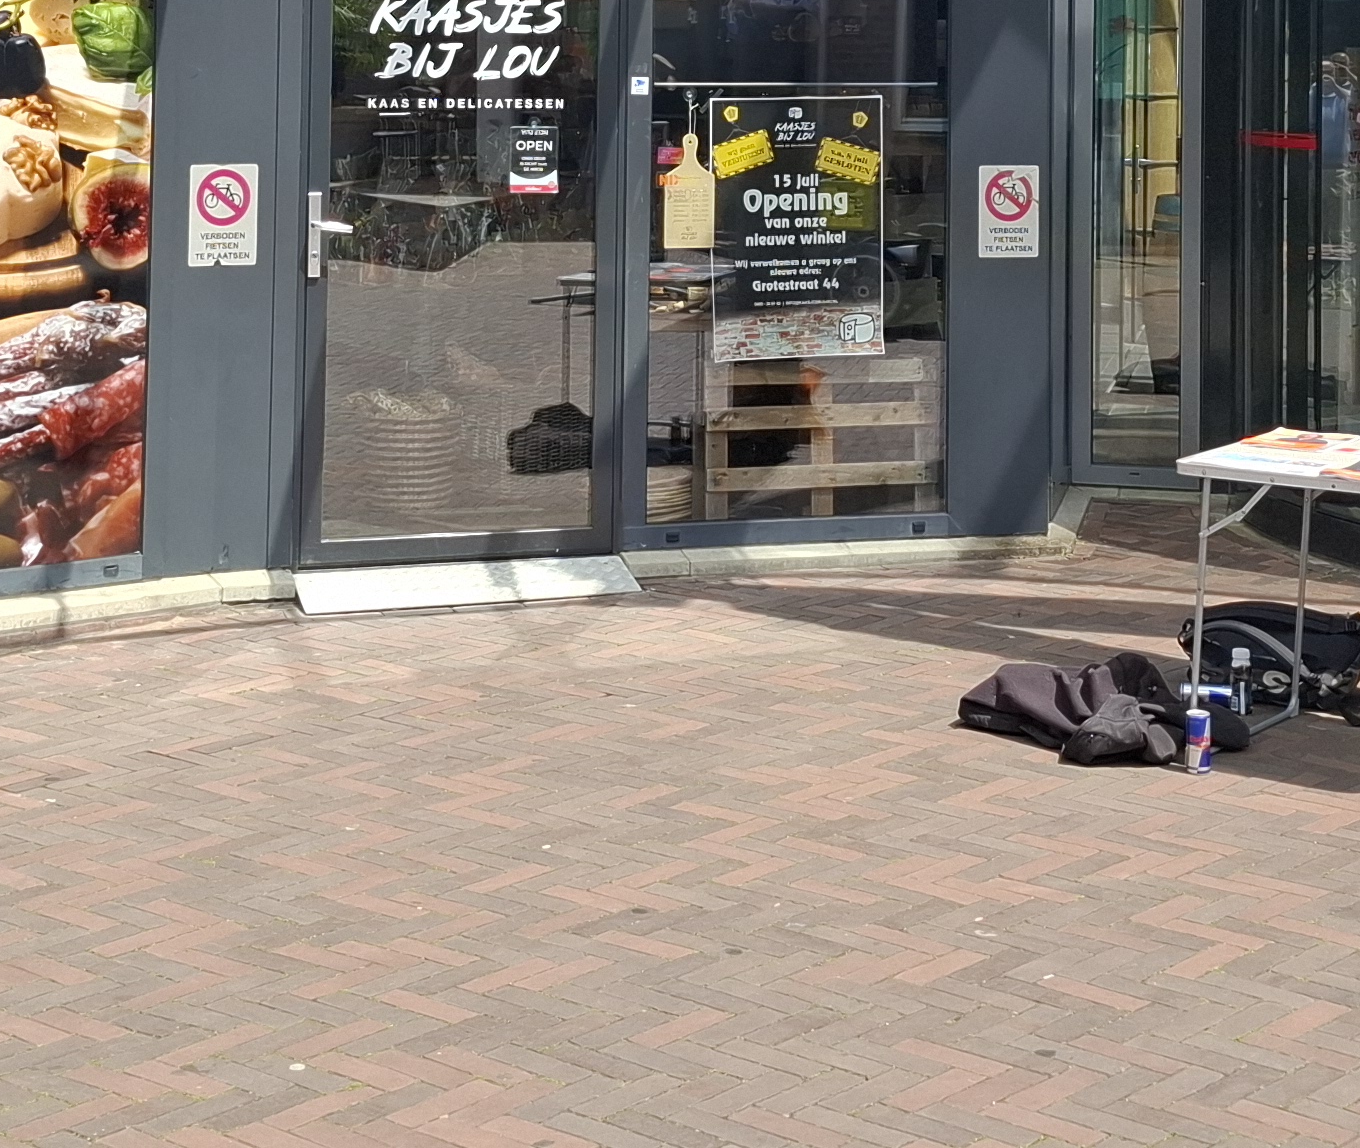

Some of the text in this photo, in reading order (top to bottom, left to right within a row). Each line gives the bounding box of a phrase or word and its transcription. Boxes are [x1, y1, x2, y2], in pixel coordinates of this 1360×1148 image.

[374, 42, 561, 81] BIJ LOU
[367, 98, 565, 109] KAAS EN DELICATESSEN
[774, 121, 817, 132] KAASJES
[776, 132, 815, 141] BIJ LOU
[515, 140, 554, 151] OPEN
[823, 155, 872, 175] GESLOTEN
[773, 173, 819, 189] 15 juli
[743, 187, 848, 218] Opening
[765, 217, 828, 229] van onze
[200, 232, 246, 240] VERBODEN
[745, 230, 846, 247] nieuwe winkel
[205, 241, 239, 249] FIETSEN
[207, 251, 250, 260] PLAATSEN
[735, 259, 748, 269] Wij
[752, 277, 840, 292] Grotestraat 44
